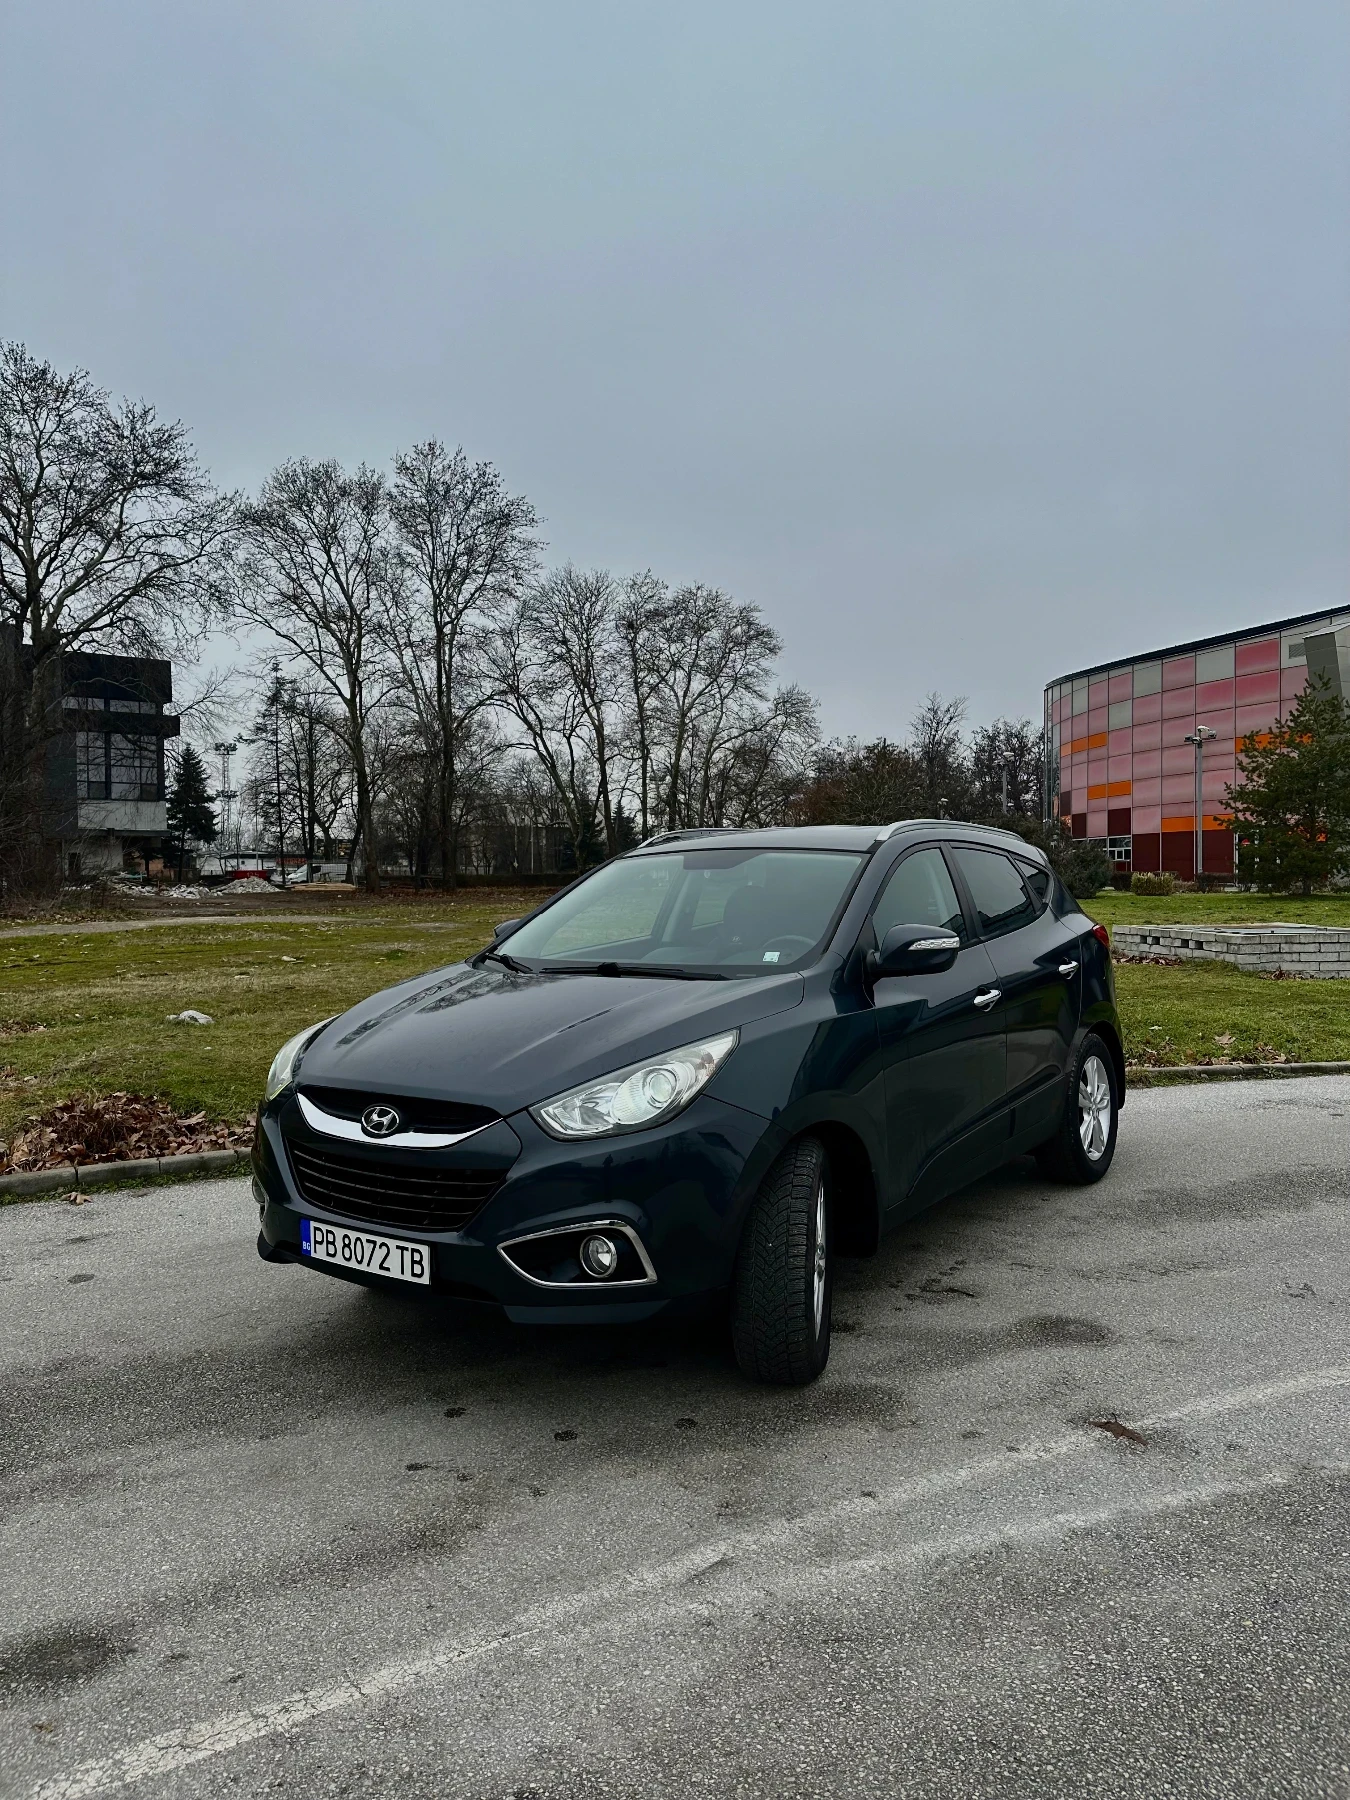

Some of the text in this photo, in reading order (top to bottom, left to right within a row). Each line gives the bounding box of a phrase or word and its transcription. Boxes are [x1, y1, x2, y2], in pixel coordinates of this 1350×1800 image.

[302, 1240, 311, 1251] BG
[313, 1226, 425, 1279] PB 8072 TB
